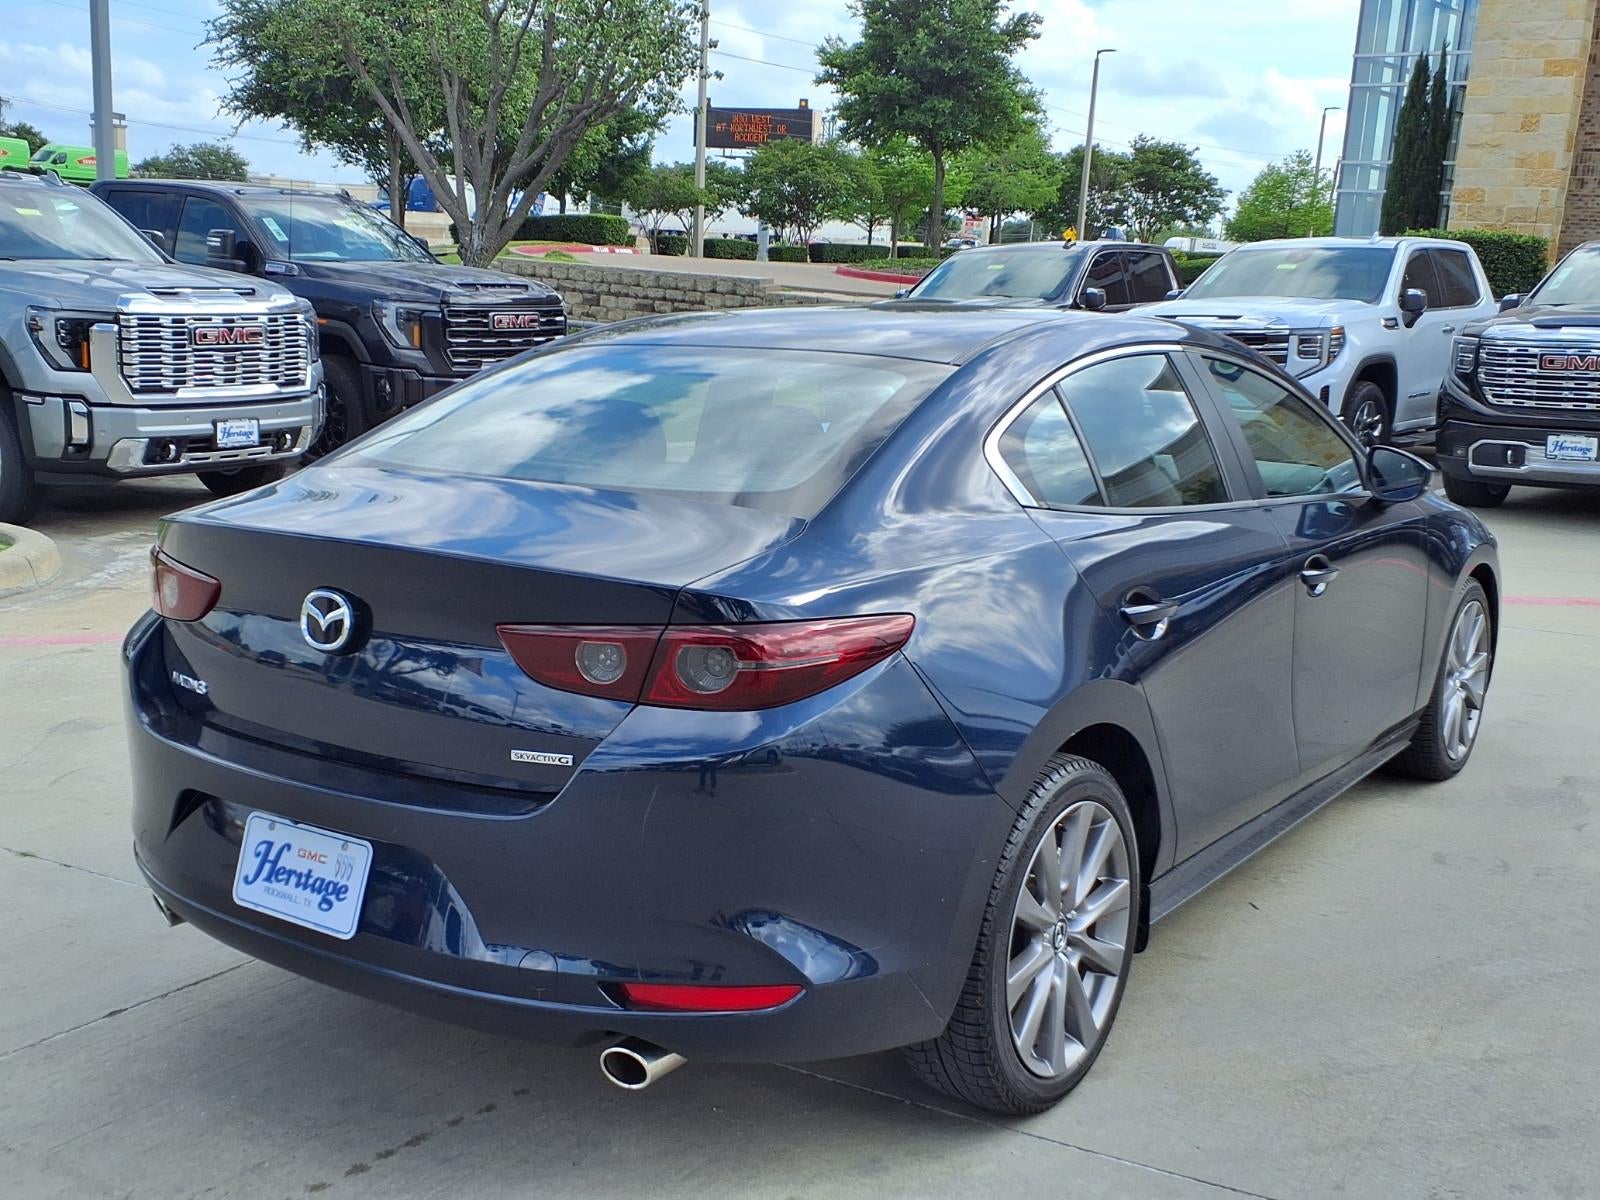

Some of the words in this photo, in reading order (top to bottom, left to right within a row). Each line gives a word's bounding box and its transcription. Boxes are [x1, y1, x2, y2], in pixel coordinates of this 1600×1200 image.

[751, 114, 772, 124] WEST
[716, 123, 727, 133] AT
[734, 133, 769, 142] ACCIDENT
[495, 315, 539, 328] GMC
[195, 327, 264, 344] GMC
[1542, 355, 1600, 370] GM
[218, 427, 255, 441] Heritage
[1549, 440, 1593, 455] Heritage
[297, 848, 328, 864] GMC
[243, 840, 349, 912] Heritage
